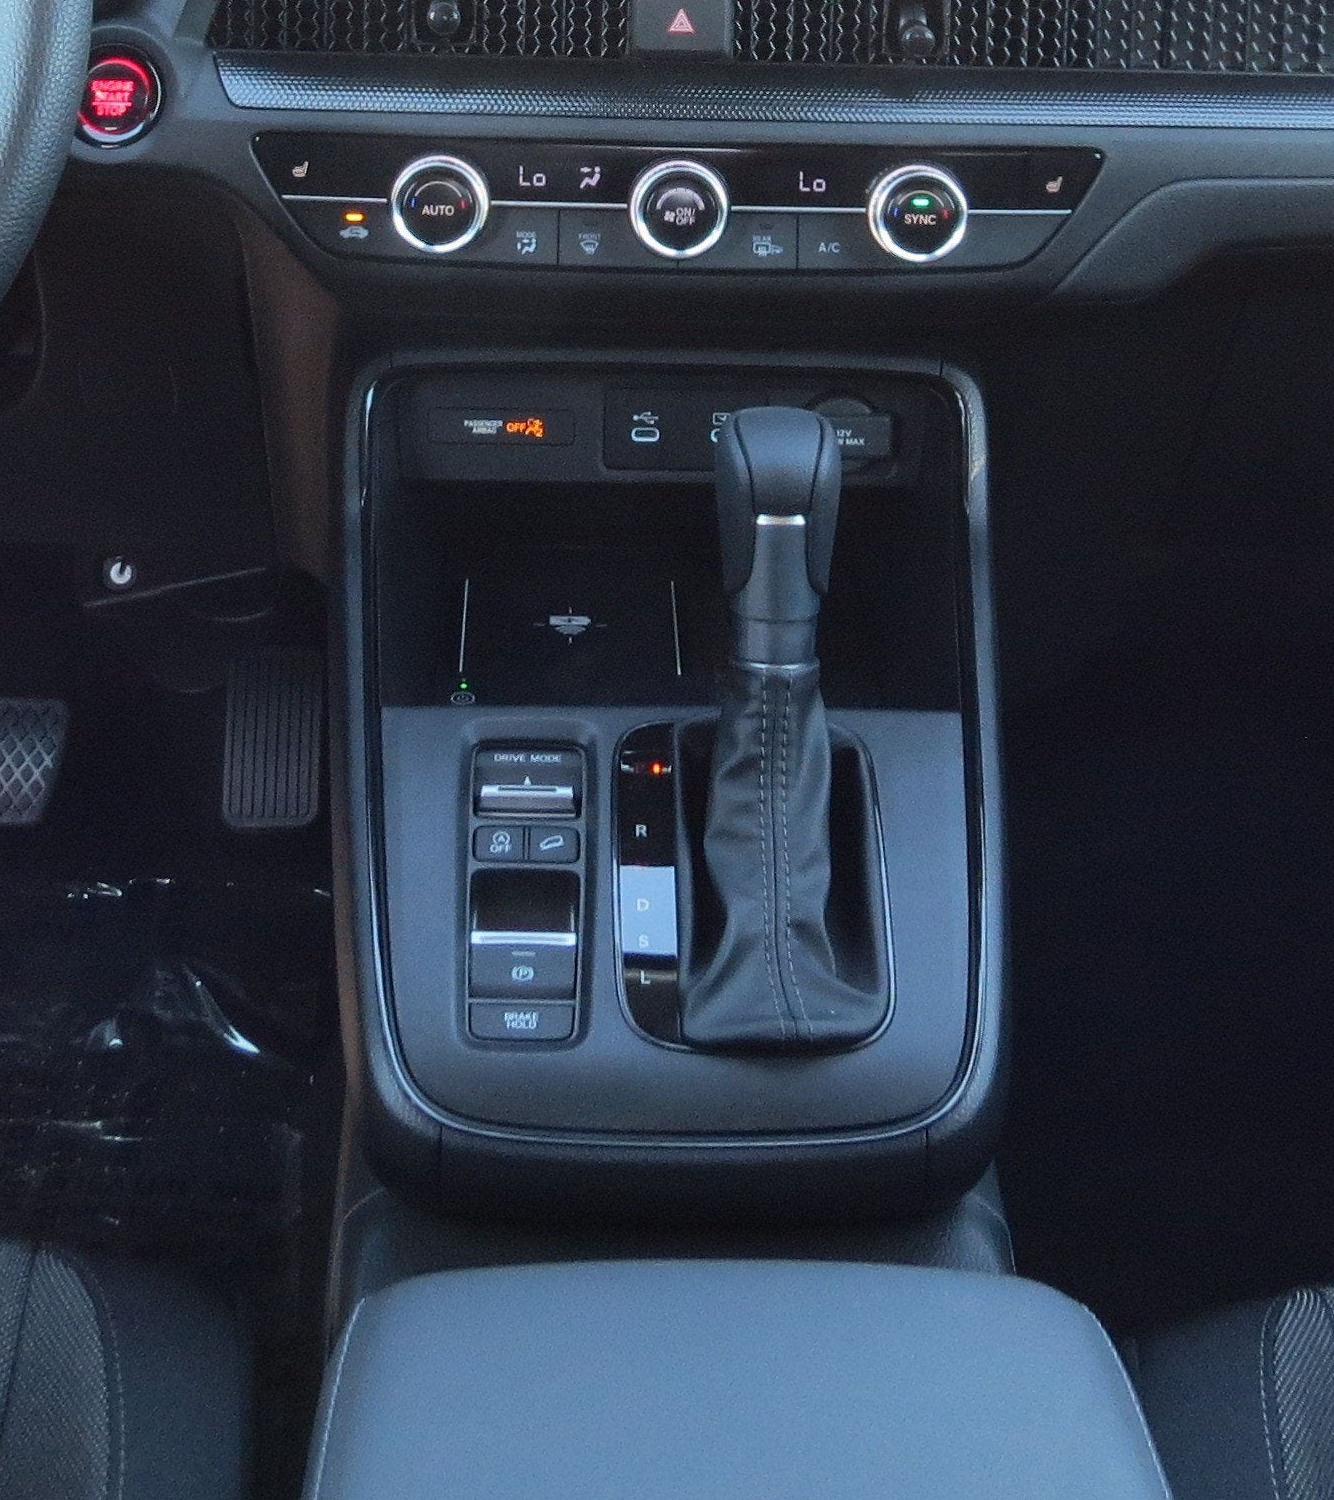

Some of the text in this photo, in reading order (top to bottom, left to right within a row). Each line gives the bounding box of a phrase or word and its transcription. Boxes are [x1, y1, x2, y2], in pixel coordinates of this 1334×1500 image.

[91, 80, 134, 92] ENGINE
[93, 91, 131, 102] START
[96, 104, 127, 116] STOP
[519, 165, 547, 187] Lo
[799, 171, 826, 192] Lo
[421, 204, 455, 217] AUTO
[676, 216, 696, 226] OFF
[904, 214, 937, 226] SYNC
[578, 233, 601, 241] FRONT
[818, 242, 840, 254] A/C
[506, 422, 526, 433] OFF
[845, 437, 865, 446] MAX
[494, 753, 563, 763] DRIVE MODE
[635, 824, 647, 838] R
[489, 843, 511, 853] OFF
[636, 898, 650, 912] D
[638, 935, 649, 948] S
[640, 970, 651, 985] L
[504, 1011, 539, 1021] BRAKE
[505, 1020, 537, 1030] HOLD
